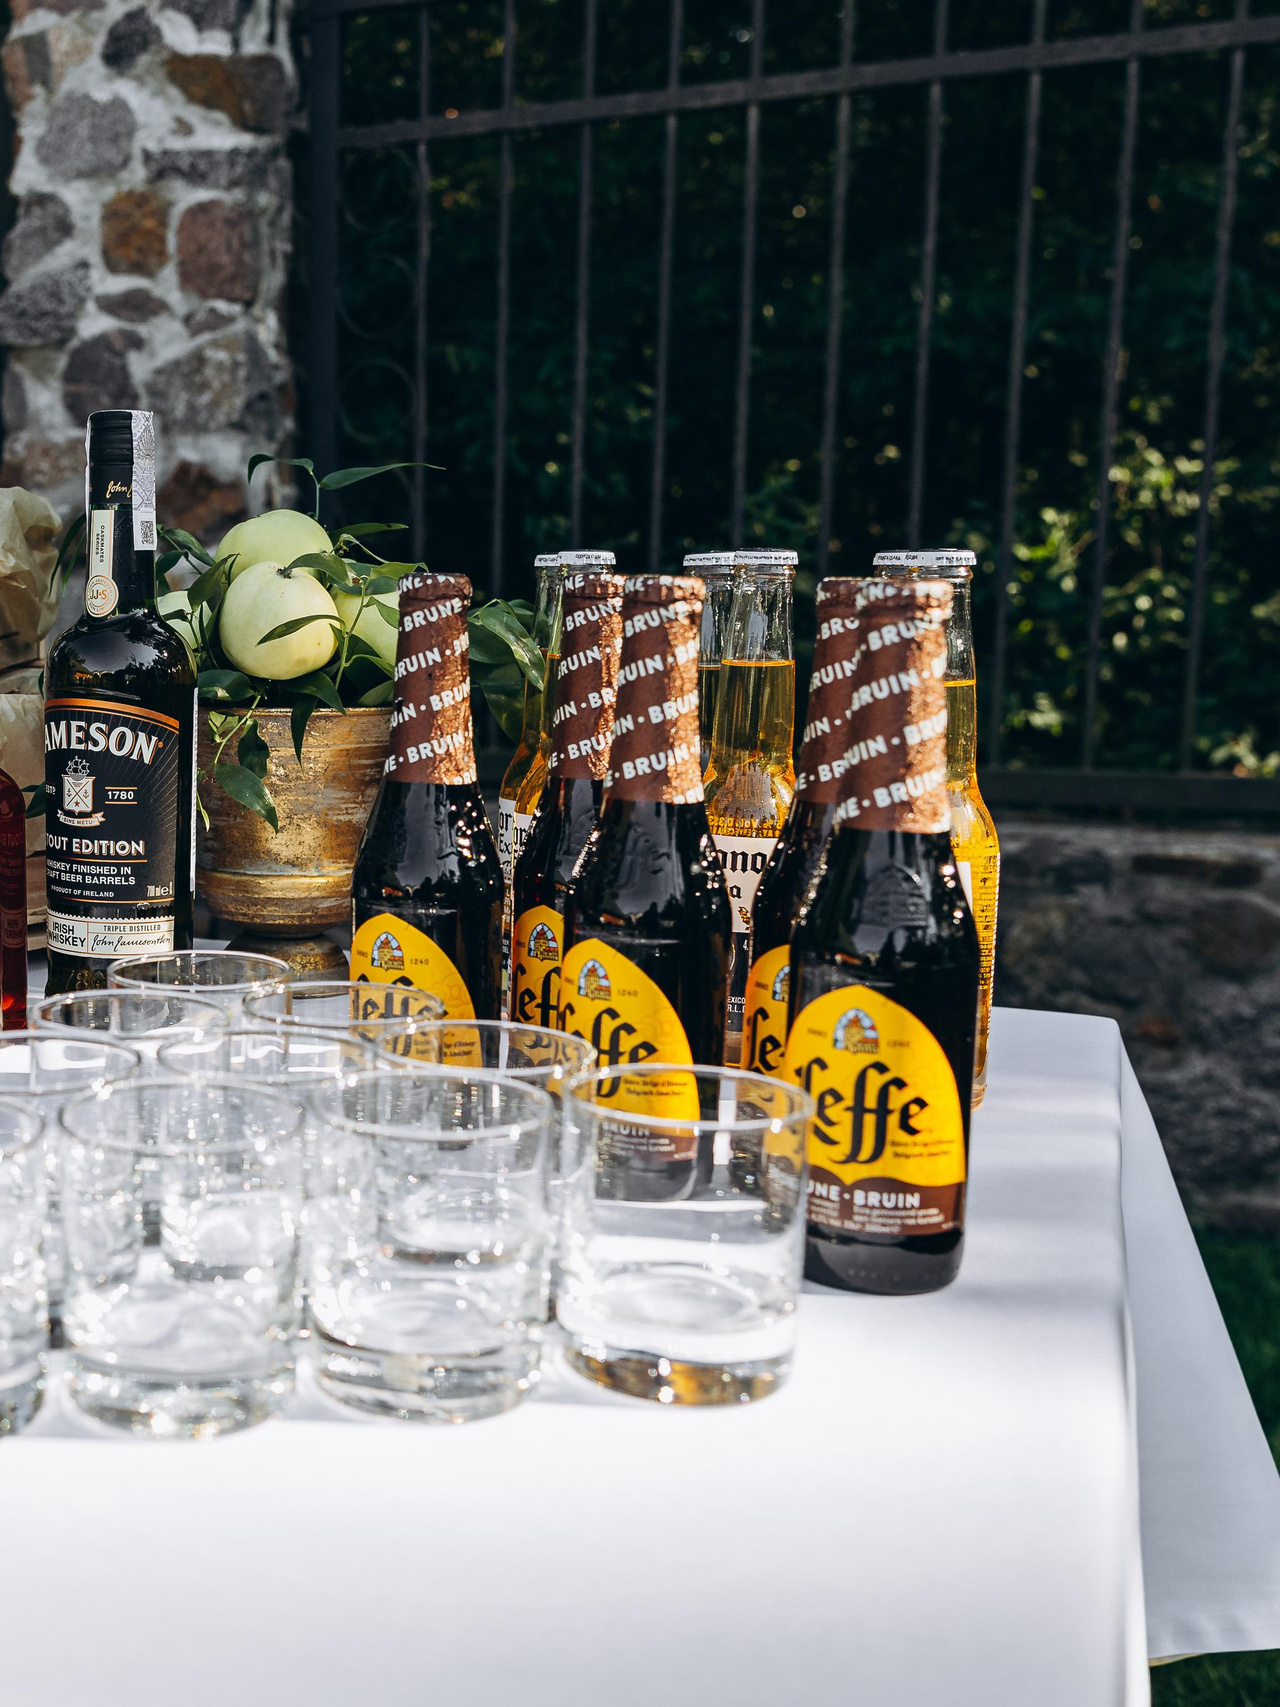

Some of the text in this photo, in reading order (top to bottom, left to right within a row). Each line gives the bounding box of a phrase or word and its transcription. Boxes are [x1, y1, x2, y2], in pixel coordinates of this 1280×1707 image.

[106, 481, 128, 499] John
[397, 574, 423, 596] UNE
[404, 597, 463, 633] BRUNE
[821, 617, 860, 641] BRU
[390, 676, 470, 728] UIN BRUN
[552, 701, 578, 728] UIN
[648, 690, 700, 724] BRUN
[803, 717, 831, 744] UIN
[904, 707, 948, 746] BRU
[44, 720, 159, 765] AMESON
[406, 730, 465, 764] BRUIN
[622, 745, 690, 780] BRUIN
[107, 791, 134, 800] 1780
[46, 833, 146, 856] TOUT EDITION
[61, 872, 83, 884] BEER
[85, 875, 136, 885] BARRELS
[73, 864, 117, 875] FINISHED
[120, 867, 131, 875] IN
[51, 885, 72, 895] PRODUCT
[83, 890, 115, 898] IRELAND
[48, 931, 86, 947] WHISKEY
[52, 921, 75, 936] IRISH
[103, 924, 161, 933] TRIPLE DISTILLED
[728, 996, 745, 1004] EXICO
[563, 1003, 659, 1098] Lffe
[794, 1056, 929, 1165] Leffe
[806, 1179, 920, 1209] UNE BRUIN
